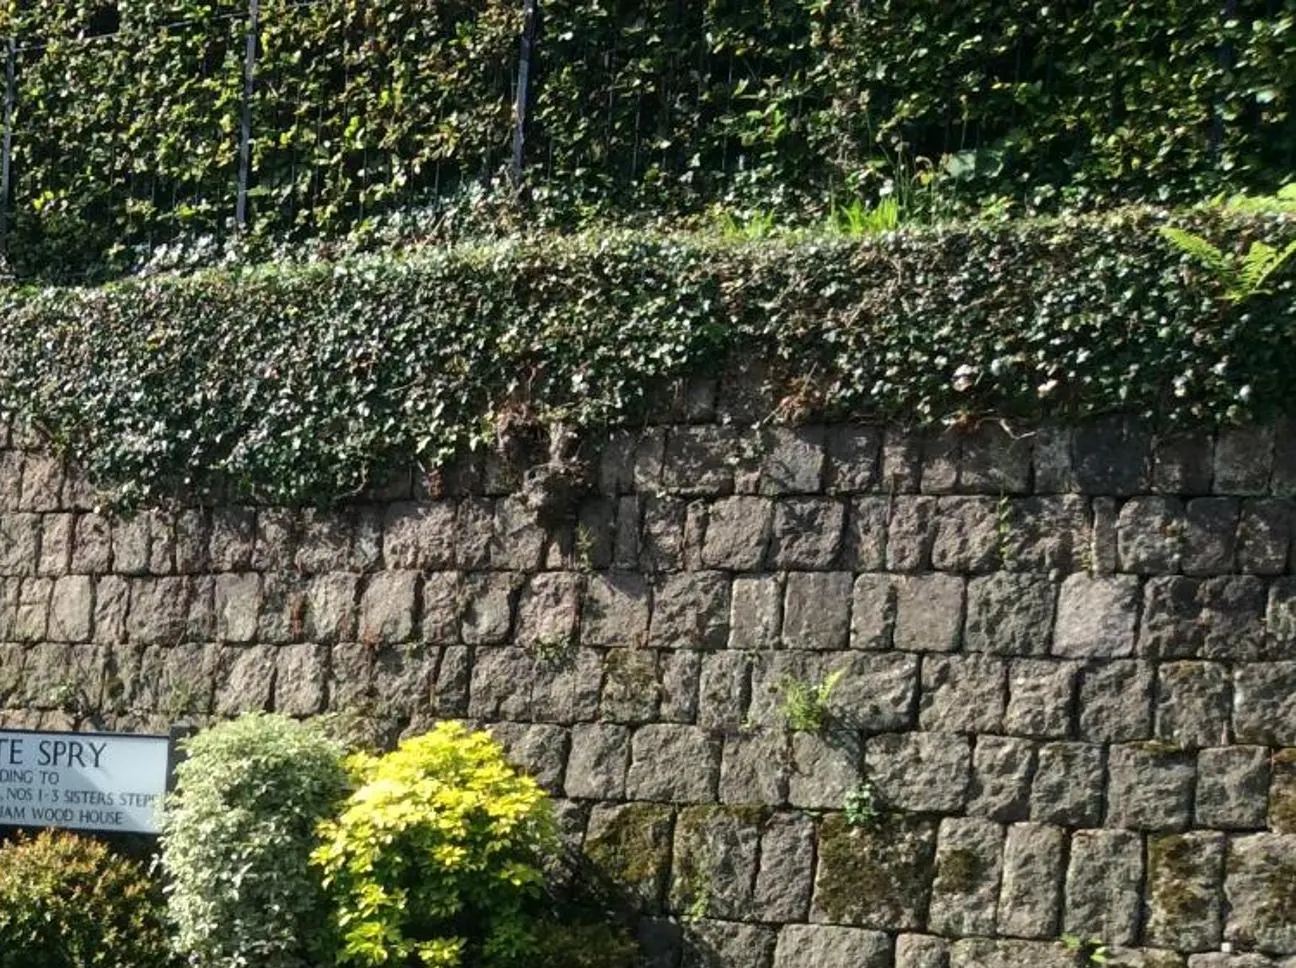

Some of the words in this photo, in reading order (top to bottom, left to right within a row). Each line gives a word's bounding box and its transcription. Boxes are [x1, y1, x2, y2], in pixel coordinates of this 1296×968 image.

[37, 740, 107, 768] SPRY
[39, 771, 60, 785] TO
[7, 787, 33, 801] NOS
[63, 789, 114, 806] SISTERS
[32, 807, 74, 821] WOOD
[79, 810, 124, 825] HOUSE
